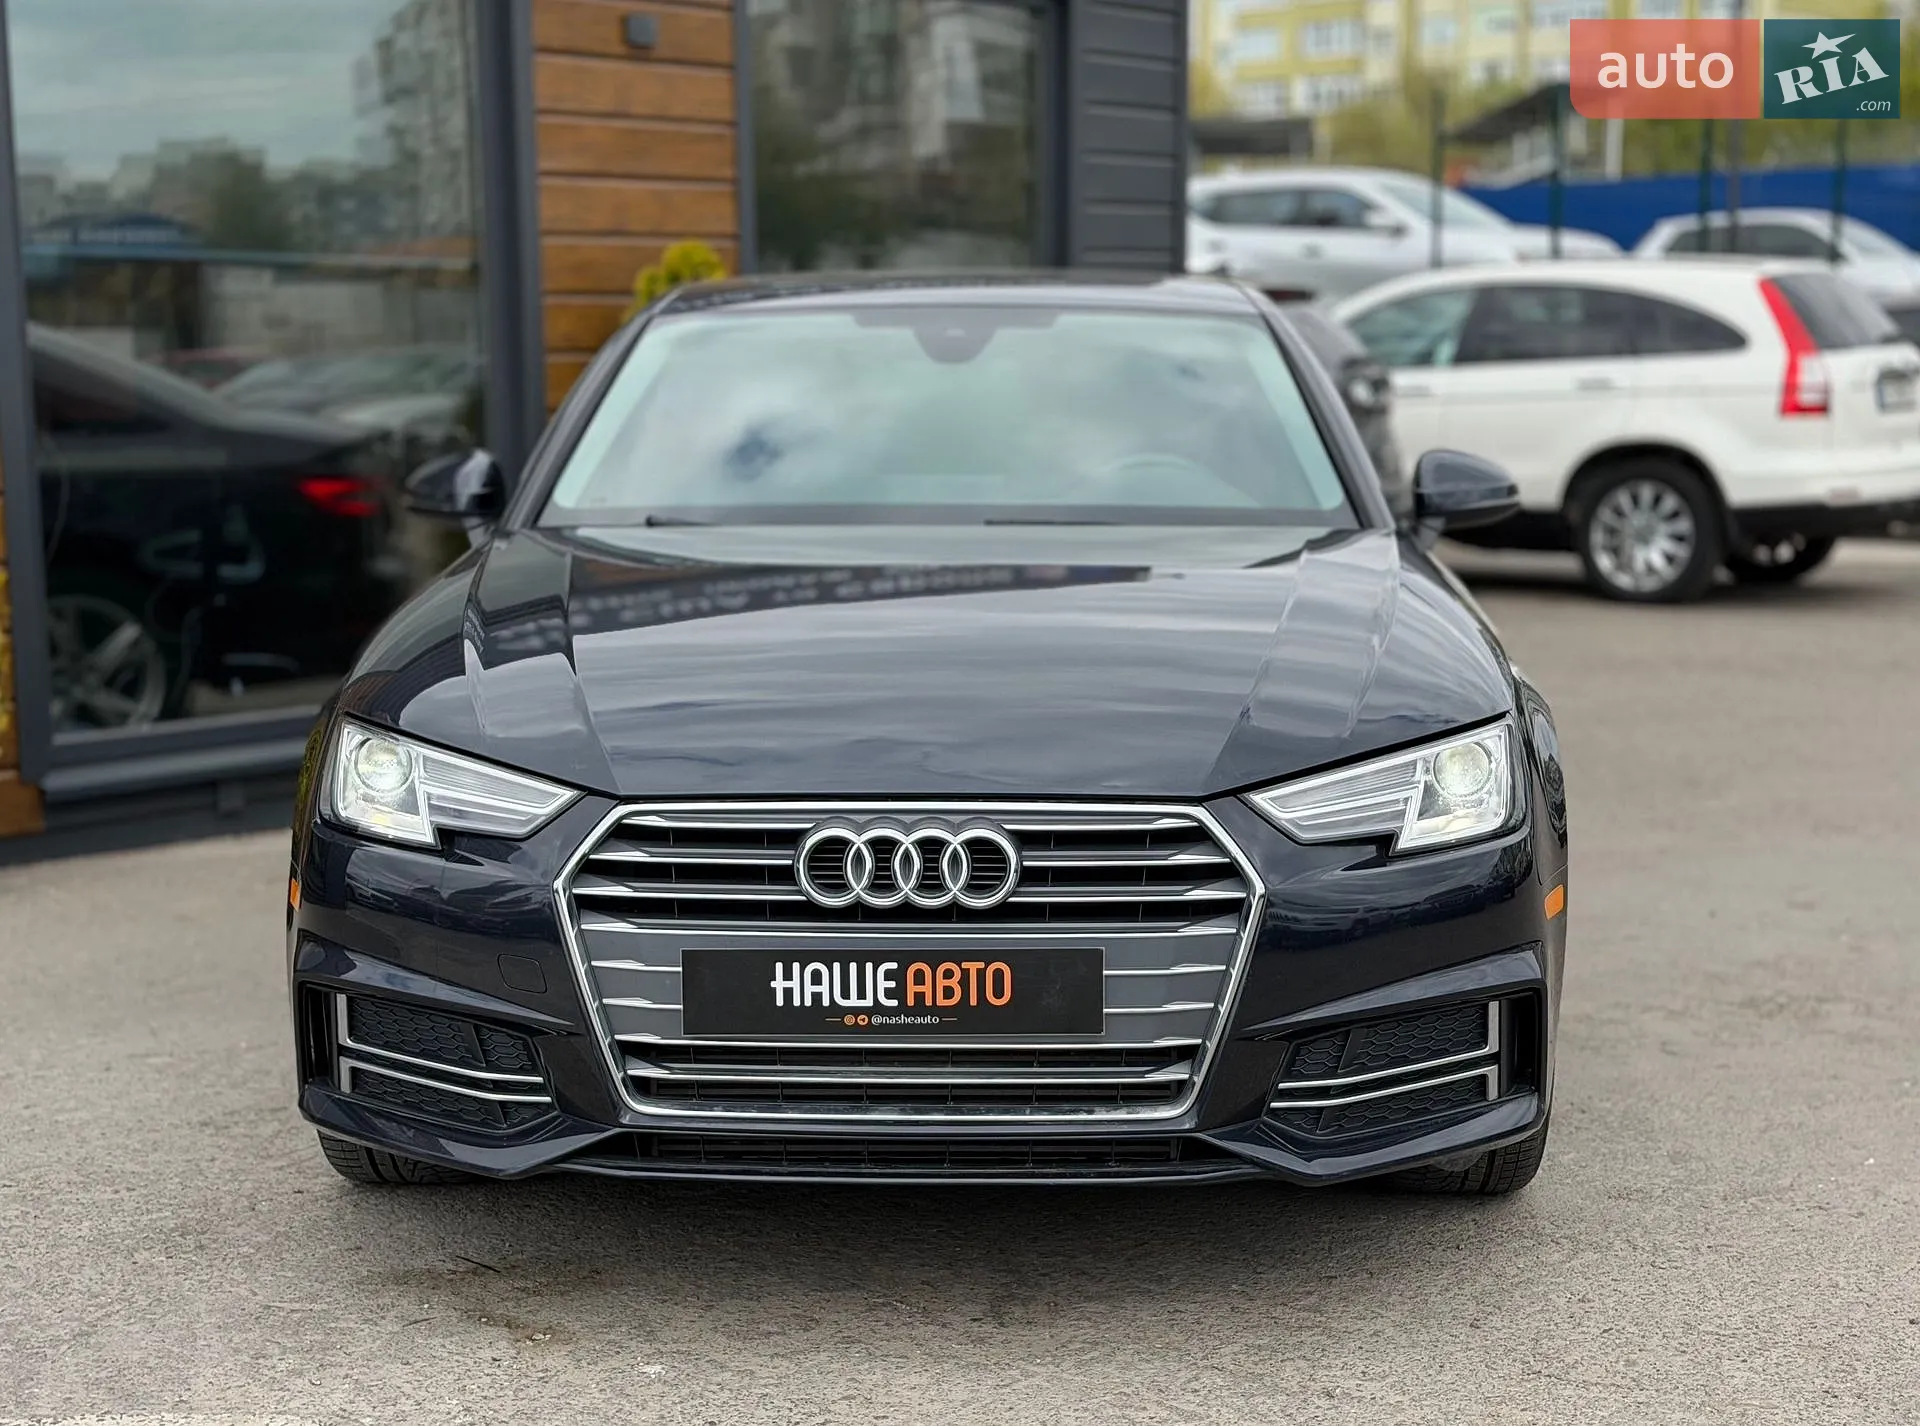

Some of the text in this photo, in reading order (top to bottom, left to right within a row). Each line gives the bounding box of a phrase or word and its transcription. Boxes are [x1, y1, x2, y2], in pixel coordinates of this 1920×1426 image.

[771, 961, 1012, 1007] НАШЕ АВТО
[871, 1014, 940, 1026] @nasheauto
